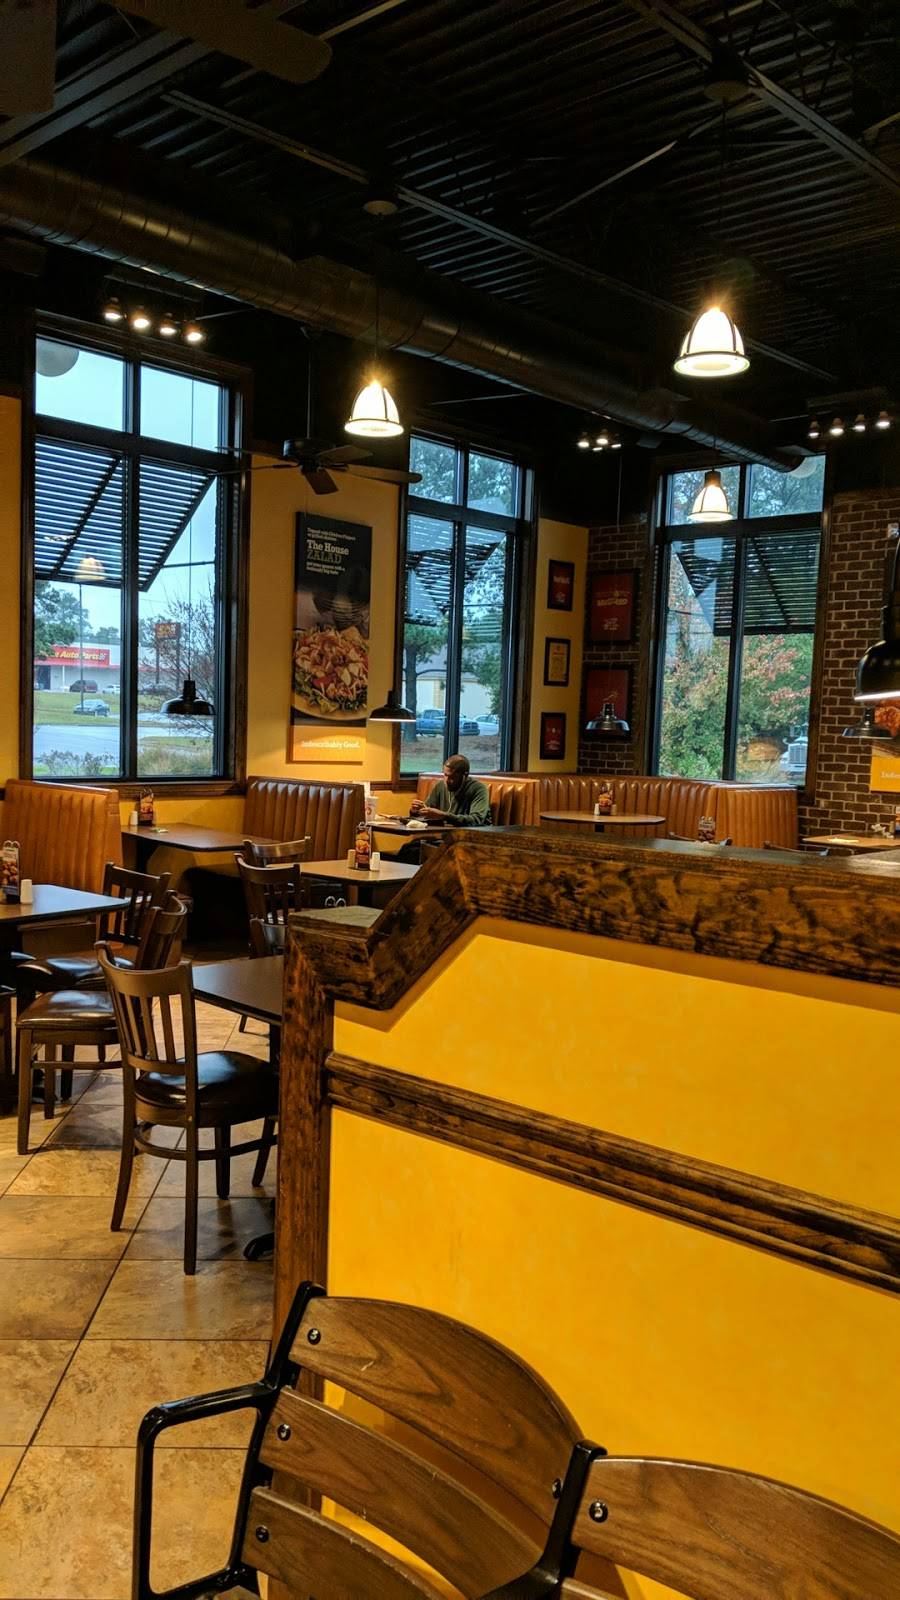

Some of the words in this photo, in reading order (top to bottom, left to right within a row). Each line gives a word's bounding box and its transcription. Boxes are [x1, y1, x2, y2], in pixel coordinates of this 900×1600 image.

[307, 540, 323, 550] The
[325, 543, 349, 555] House
[307, 550, 342, 564] ZALAD
[60, 651, 79, 659] Auto
